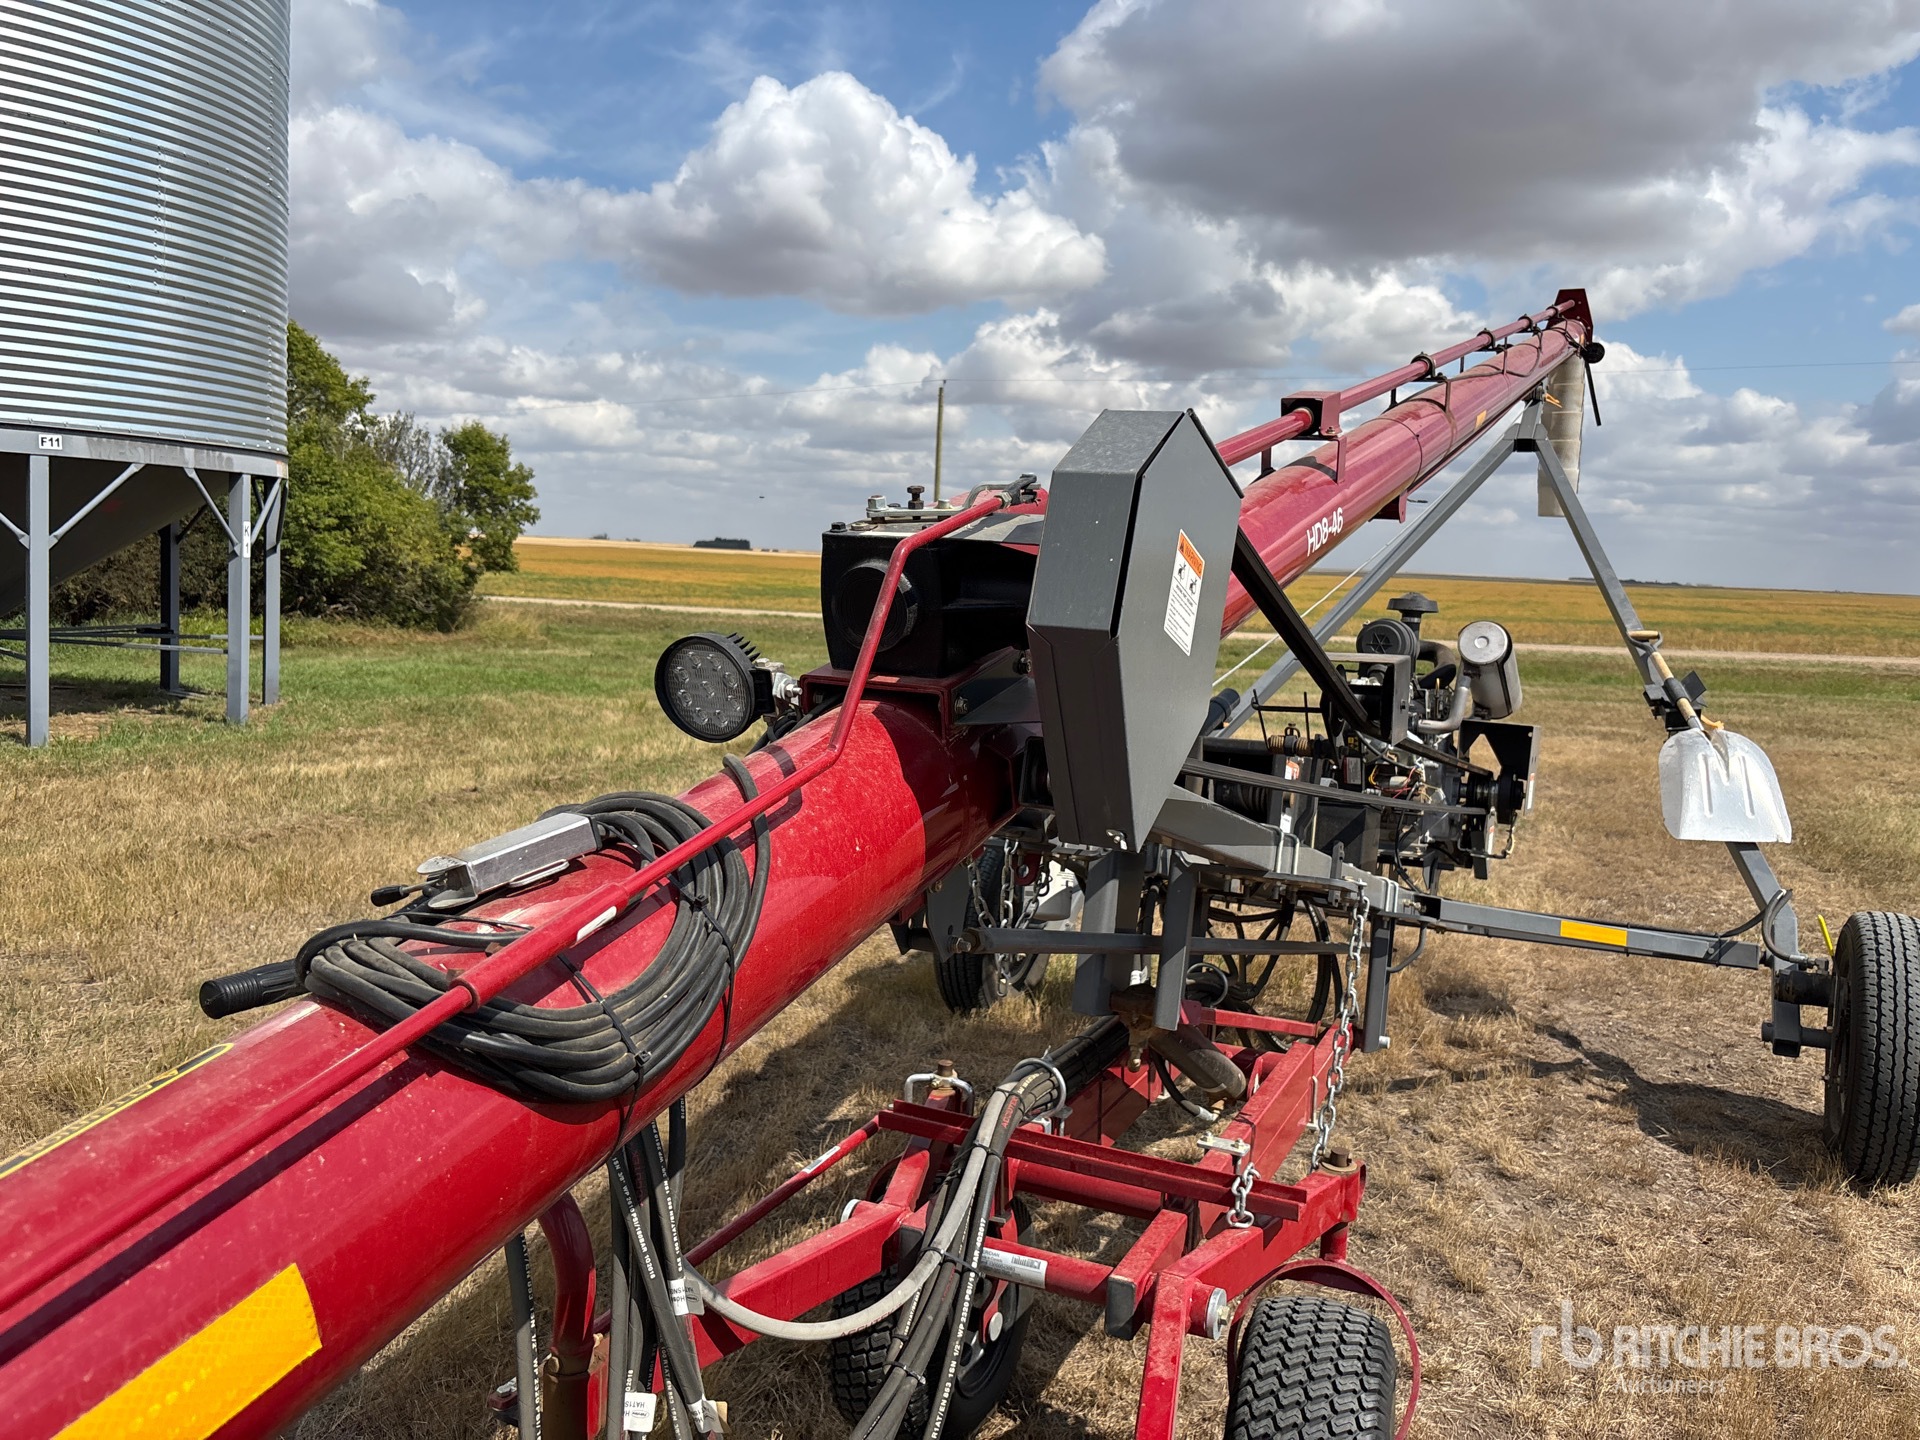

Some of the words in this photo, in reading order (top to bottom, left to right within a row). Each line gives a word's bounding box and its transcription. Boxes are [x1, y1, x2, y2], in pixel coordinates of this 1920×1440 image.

[40, 436, 60, 447] F11
[1306, 507, 1344, 557] HD8-46
[622, 1186, 630, 1197] WP
[931, 1399, 947, 1439] R1AT/EN
[943, 1382, 952, 1398] 853
[948, 1361, 957, 1378] 1SN
[957, 1323, 965, 1337] WP
[961, 1302, 970, 1323] 2320
